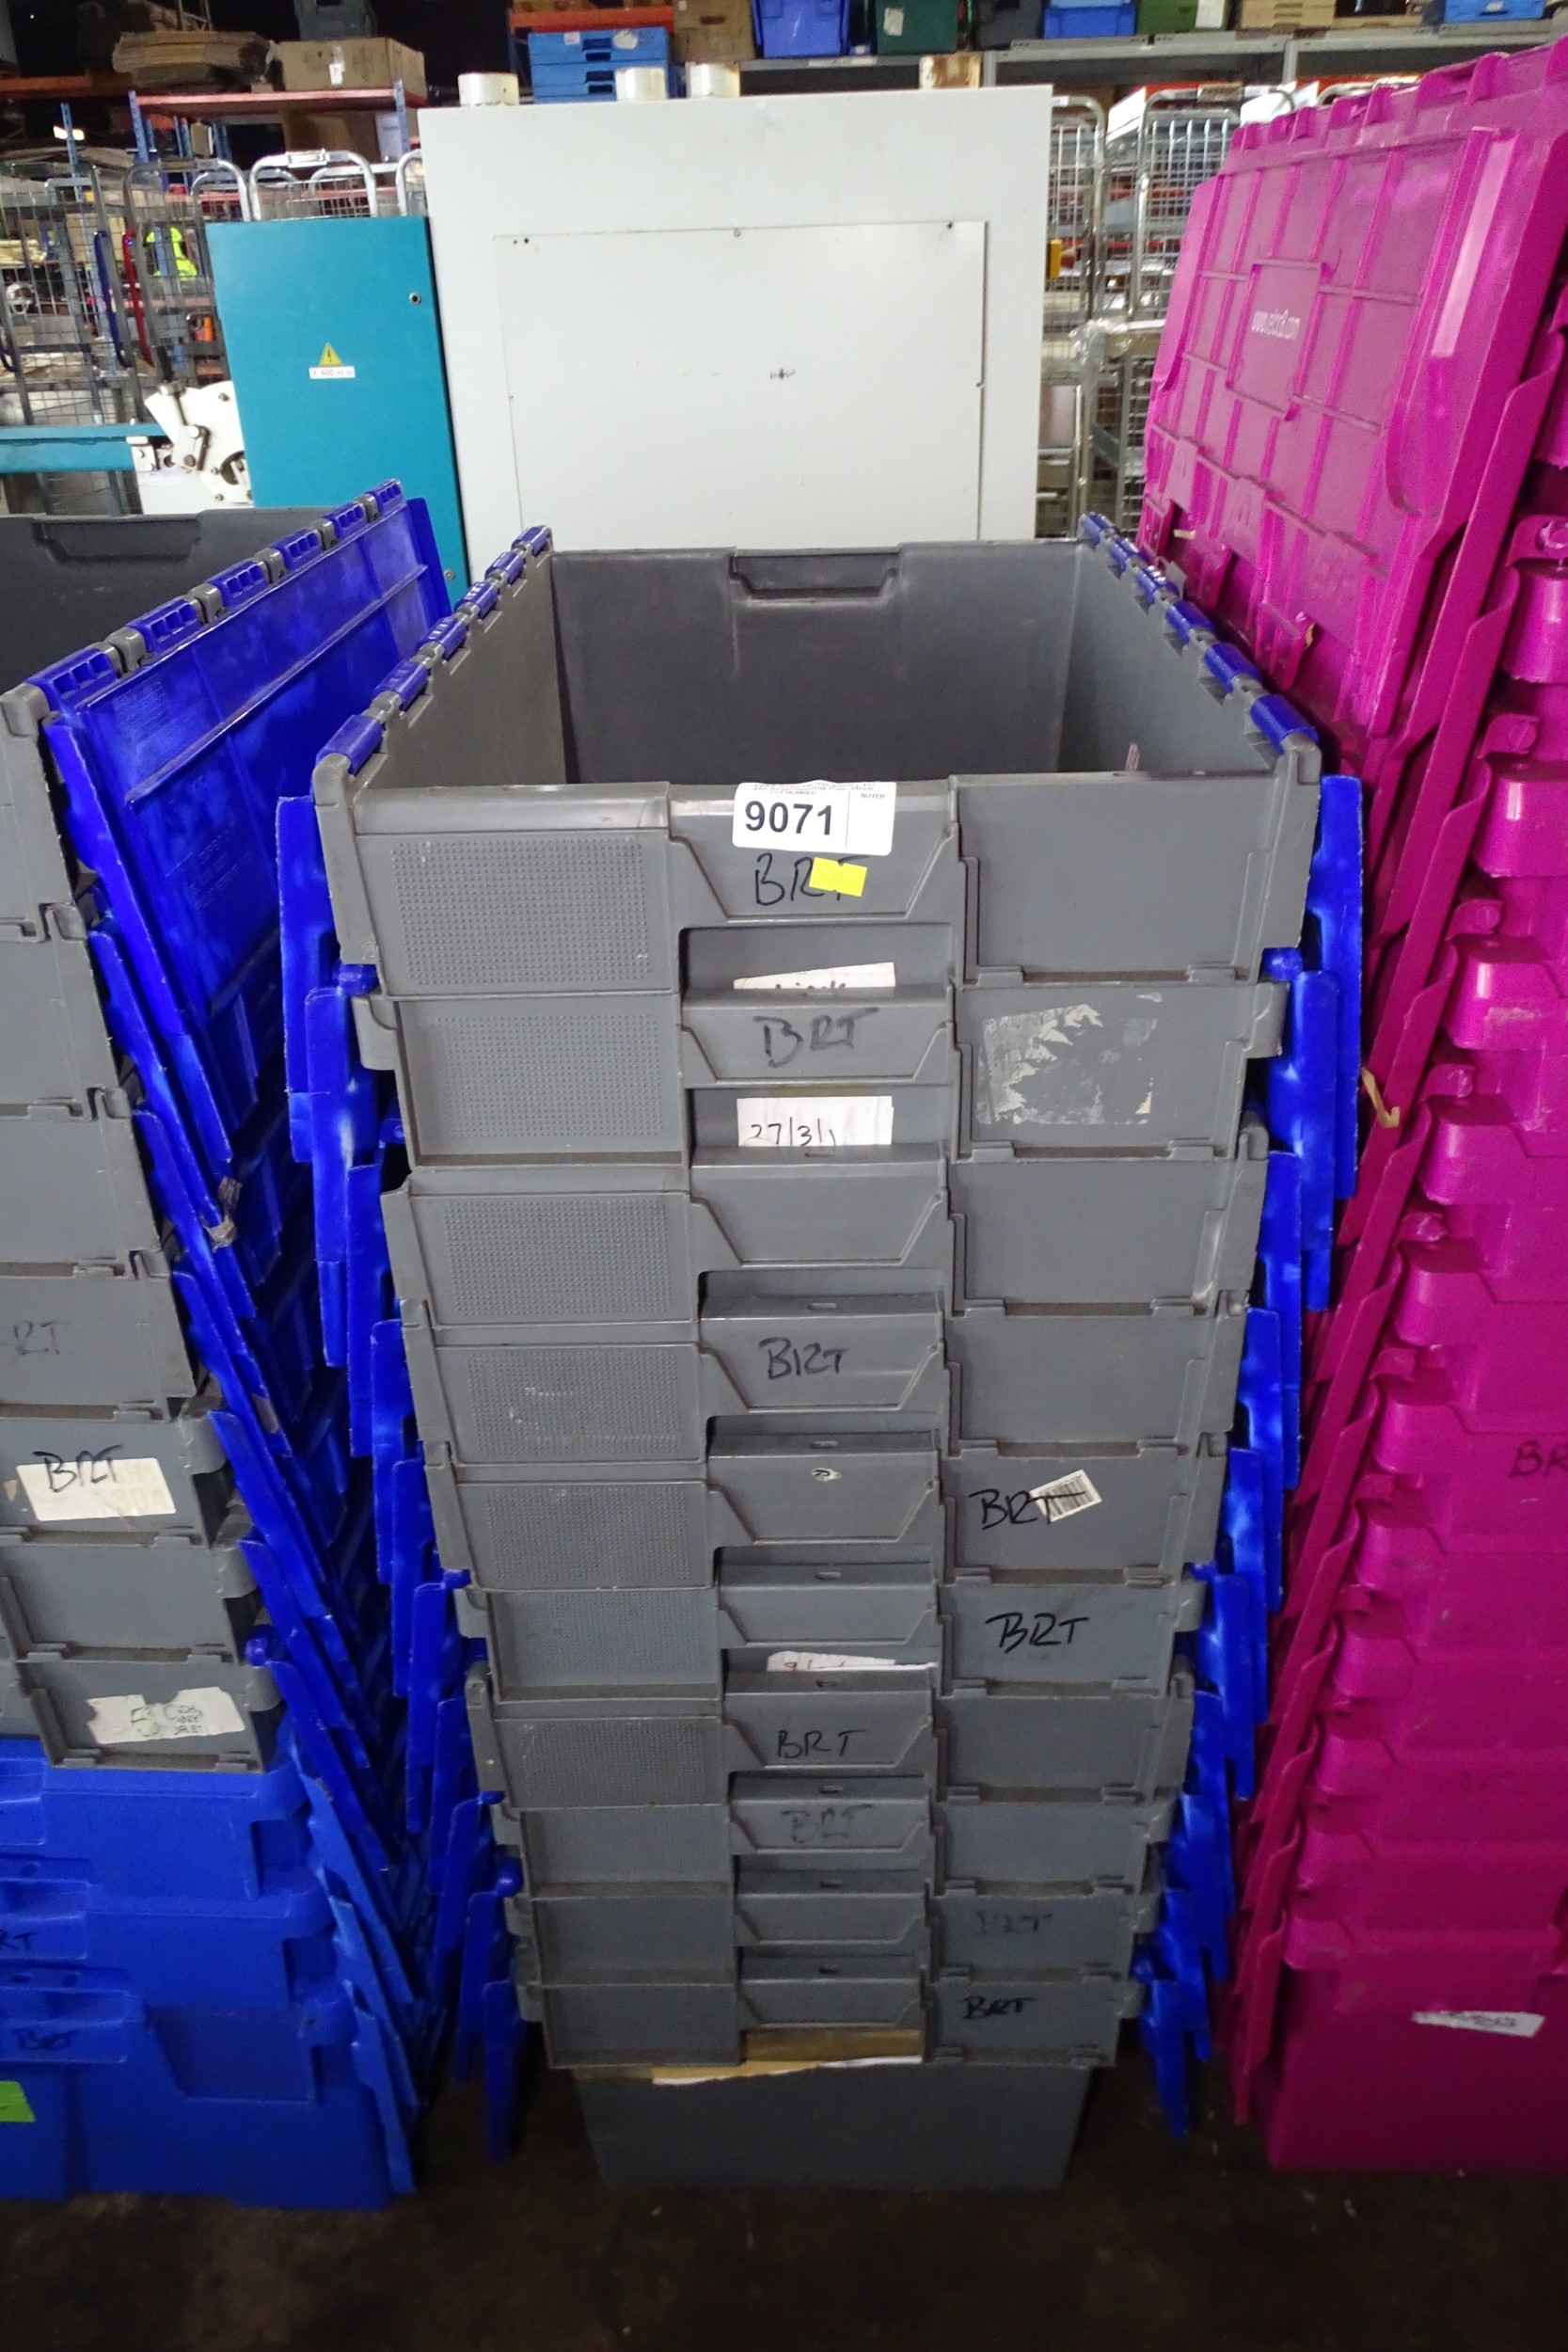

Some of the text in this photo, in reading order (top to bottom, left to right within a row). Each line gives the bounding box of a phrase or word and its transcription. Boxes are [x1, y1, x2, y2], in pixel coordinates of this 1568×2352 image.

[744, 800, 832, 836] 9071
[752, 1007, 880, 1069] BRT
[968, 1488, 1086, 1531] BRT
[985, 1612, 1089, 1654] BRT
[777, 1729, 866, 1759] BRT
